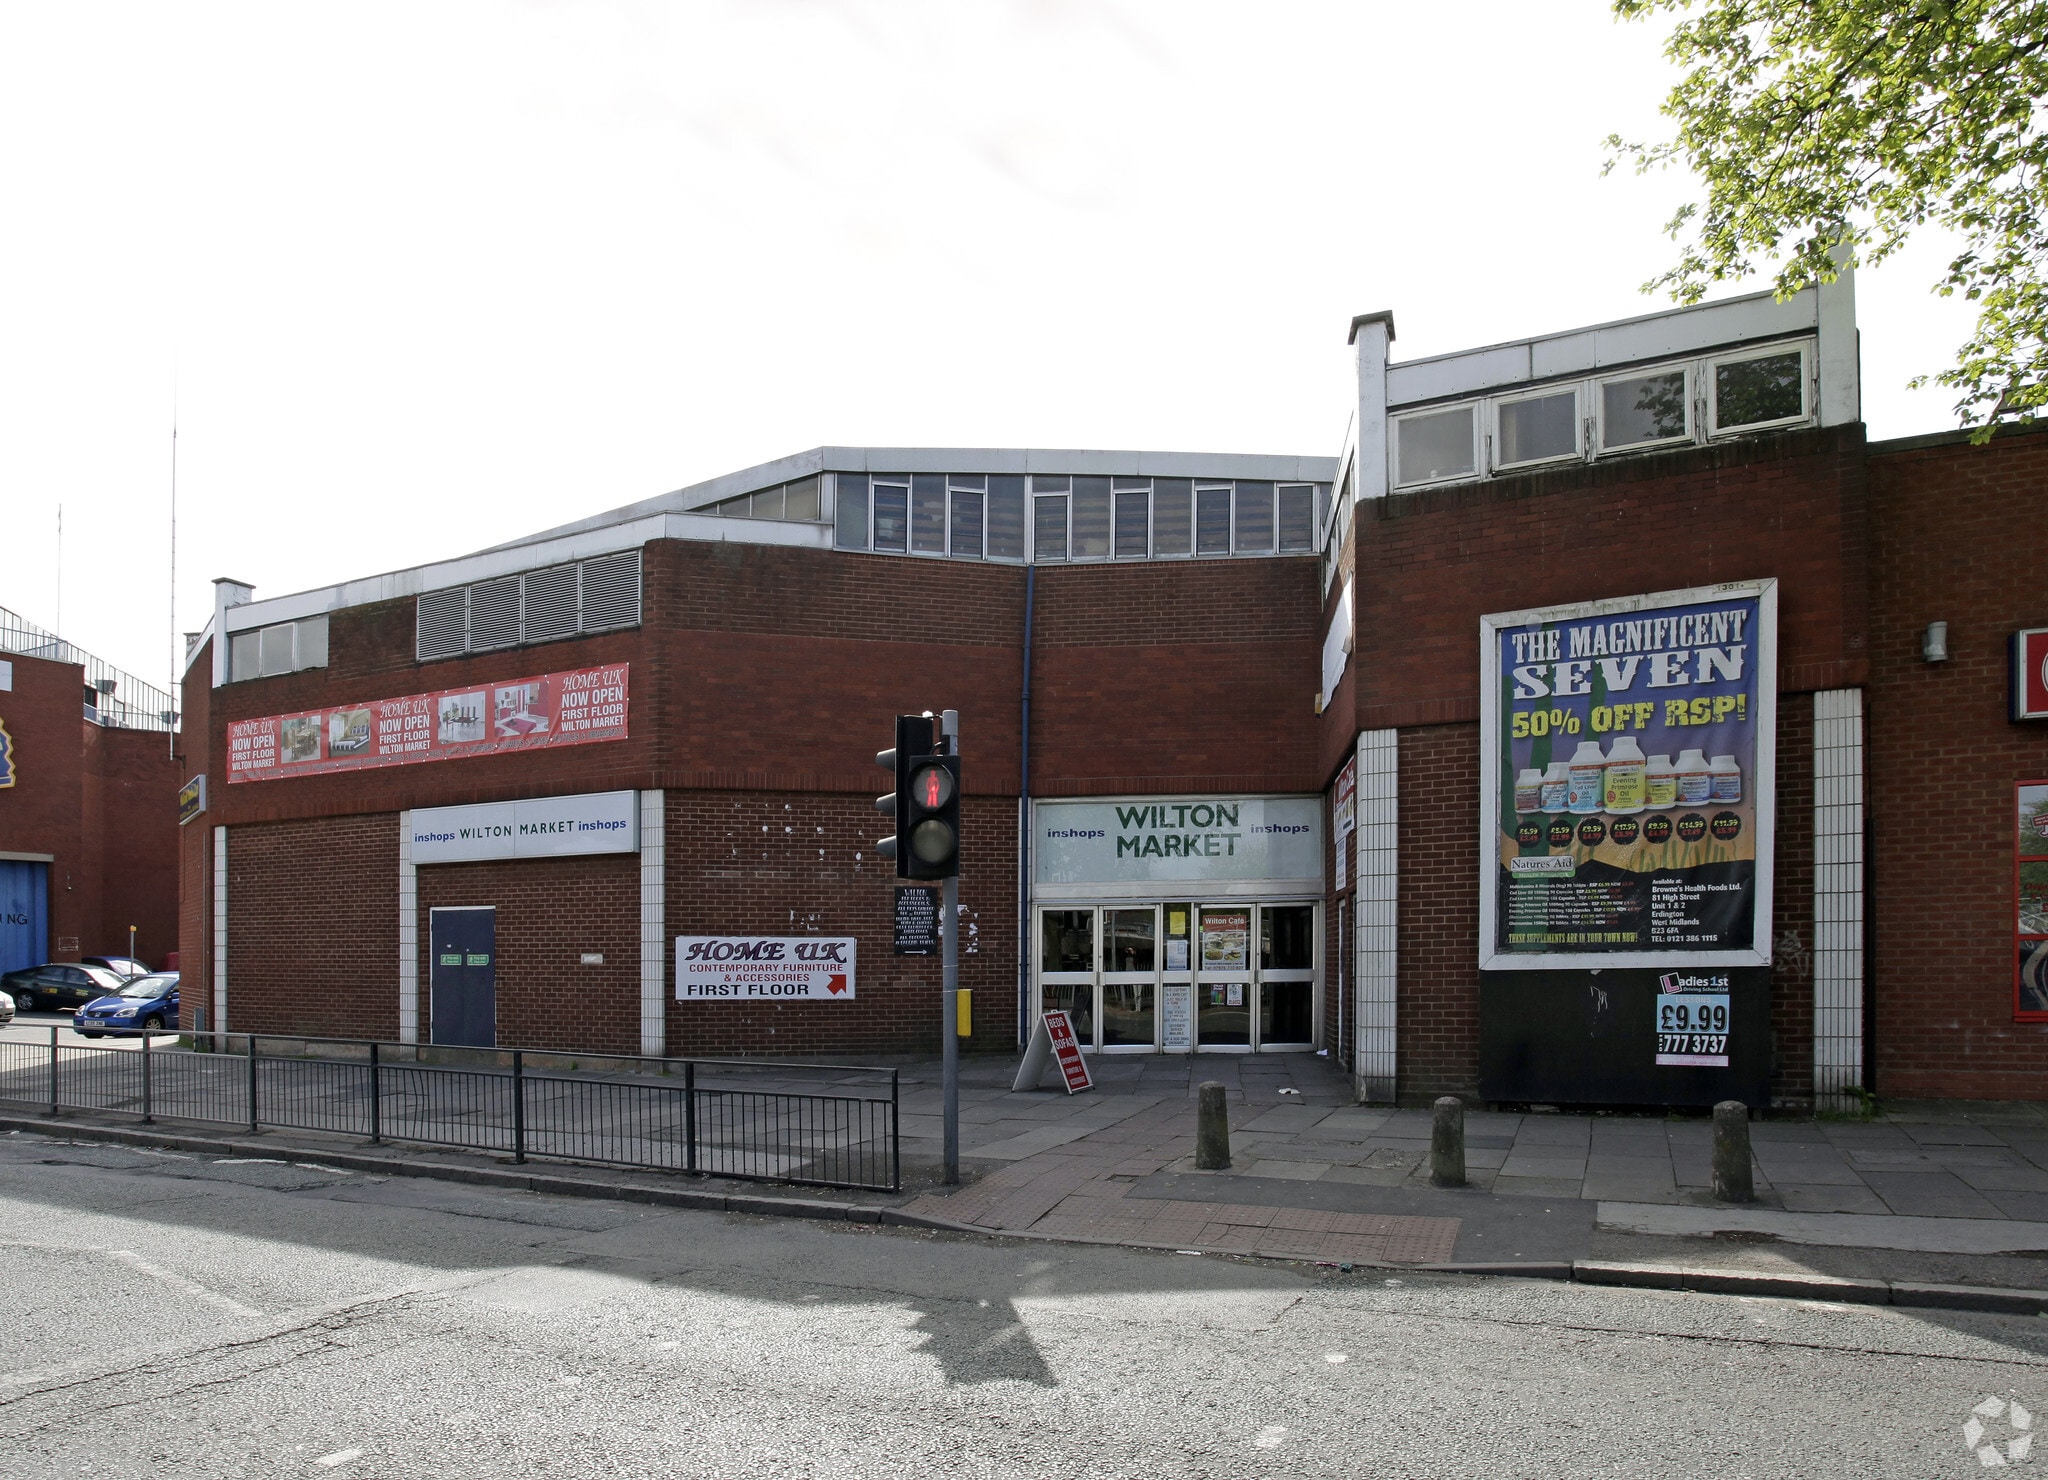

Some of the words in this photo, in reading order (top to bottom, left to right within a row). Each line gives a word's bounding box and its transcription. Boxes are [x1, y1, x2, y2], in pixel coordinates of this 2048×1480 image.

[1512, 630, 1560, 663] THE
[1569, 609, 1747, 659] MAGNIFICENT
[562, 672, 600, 692] HOME
[602, 669, 624, 687] UK
[1512, 644, 1747, 700] SEVEN
[562, 692, 590, 708] NOW
[592, 686, 623, 704] OPEN
[380, 701, 411, 718] HOME
[413, 698, 431, 716] UK
[562, 708, 588, 720] FIRST
[592, 704, 624, 717] FLOOR
[1512, 708, 1580, 738] 50%
[1591, 702, 1654, 732] OFF
[1664, 694, 1746, 726] RSP!
[233, 722, 260, 737] HOME
[261, 720, 276, 734] UK
[380, 718, 402, 734] NOW
[404, 714, 430, 730] OPEN
[562, 720, 590, 732] WILTON
[593, 715, 624, 729] MARKET
[232, 738, 252, 752] NOW
[253, 735, 275, 748] OPEN
[380, 734, 402, 744] FIRST
[404, 730, 430, 742] FLOOR
[232, 751, 251, 762] FIRST
[252, 749, 275, 760] FLOOR
[379, 744, 404, 756] WILTON
[404, 740, 430, 753] MARKET
[232, 760, 252, 771] WILTON
[253, 758, 276, 769] MARKET
[1116, 804, 1240, 828] WILTON
[414, 831, 456, 843] inshops
[460, 826, 512, 840] WILTON
[520, 820, 574, 836] MARKET
[578, 819, 626, 832] inshops
[1047, 828, 1105, 838] inshops
[1250, 824, 1310, 834] inshops
[1116, 832, 1241, 858] MARKET
[1512, 860, 1550, 868] Natures
[1554, 858, 1572, 868] Aid
[1662, 894, 1678, 902] High
[1567, 933, 1578, 942] ARE
[1587, 932, 1604, 942] YOUR
[1604, 932, 1621, 942] TOWN
[1622, 932, 1638, 942] NOW!
[684, 940, 786, 962] HOME
[794, 941, 848, 964] UK
[689, 963, 779, 972] CONTEMPORARY
[783, 962, 843, 972] FURNITURE
[724, 974, 732, 982] &
[736, 974, 810, 982] ACCESSORIES
[1662, 976, 1708, 993] Ladies
[1710, 976, 1728, 986] 1st
[688, 984, 742, 996] FIRST
[748, 984, 809, 996] FLOOR
[1048, 1017, 1065, 1028] BEDS
[1661, 1005, 1727, 1031] £9.99
[1058, 1029, 1064, 1038] &
[1055, 1038, 1075, 1050] SOFAS
[1664, 1035, 1689, 1052] 777
[1692, 1035, 1726, 1053] 3737
